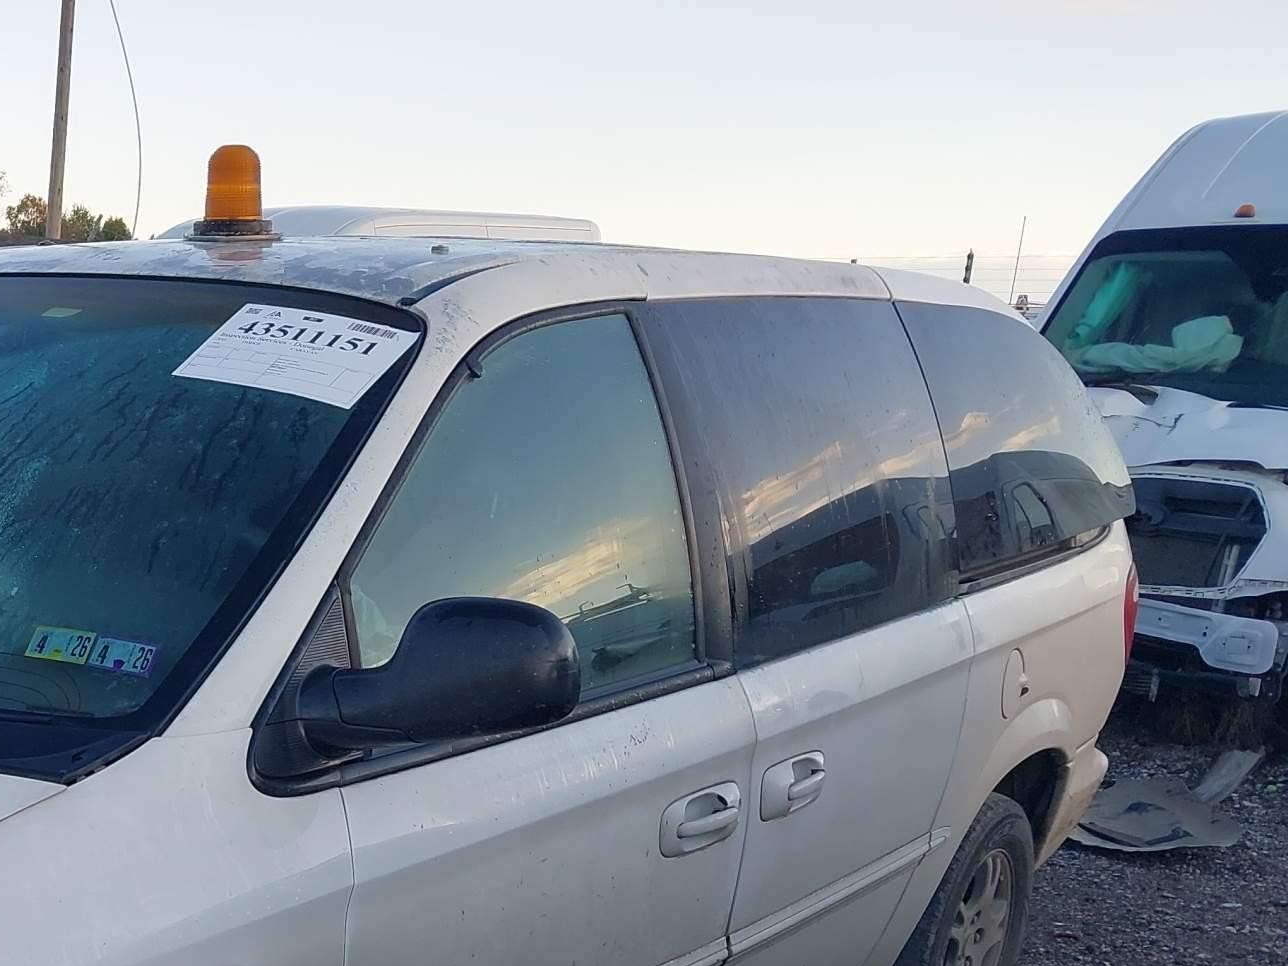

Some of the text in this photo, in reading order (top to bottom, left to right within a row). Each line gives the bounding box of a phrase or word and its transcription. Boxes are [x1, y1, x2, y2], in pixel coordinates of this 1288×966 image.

[238, 321, 379, 356] 43511151
[35, 635, 92, 658] 4 26
[97, 645, 153, 671] 4 26
